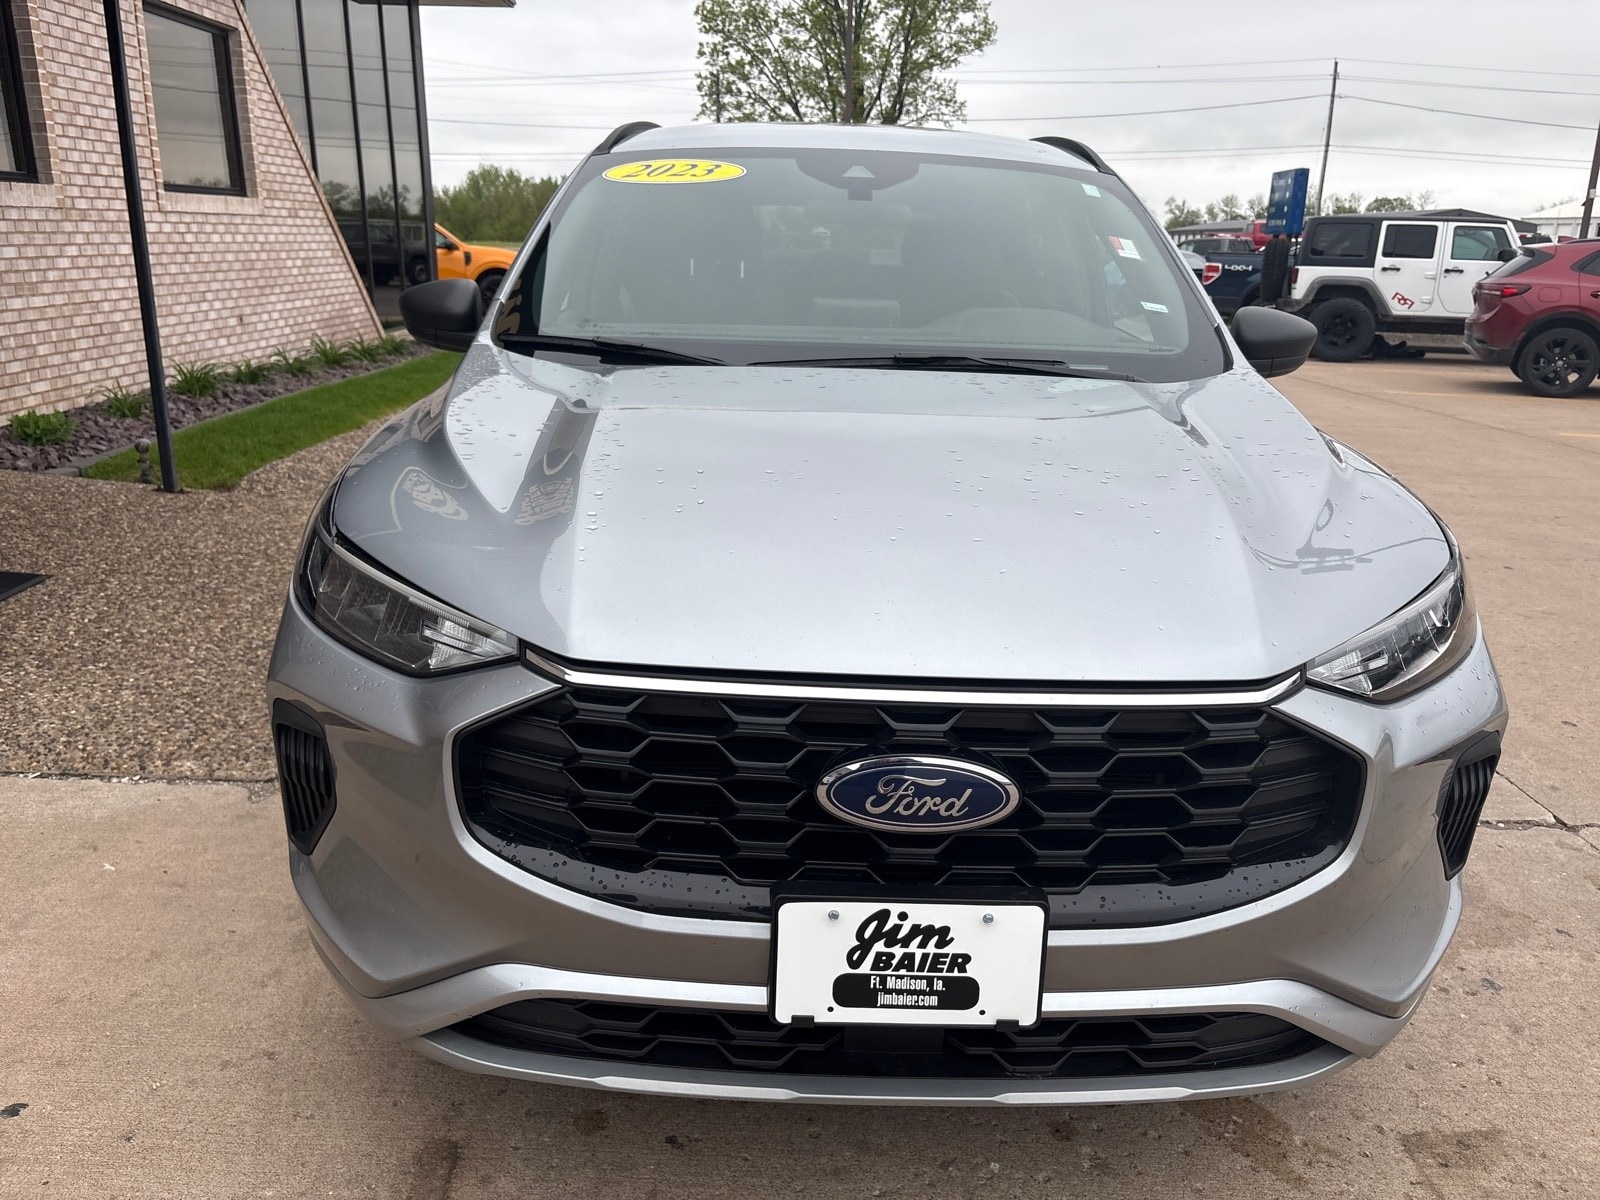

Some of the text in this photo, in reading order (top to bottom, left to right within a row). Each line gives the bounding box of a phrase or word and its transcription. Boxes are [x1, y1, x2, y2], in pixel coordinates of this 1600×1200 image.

[621, 163, 722, 178] 2023
[864, 774, 973, 818] Ford
[846, 908, 955, 971] Jim
[870, 951, 972, 974] BAIER
[870, 975, 883, 989] Ft.
[886, 976, 930, 992] Madison,
[877, 992, 939, 1007] jimbaier.com
